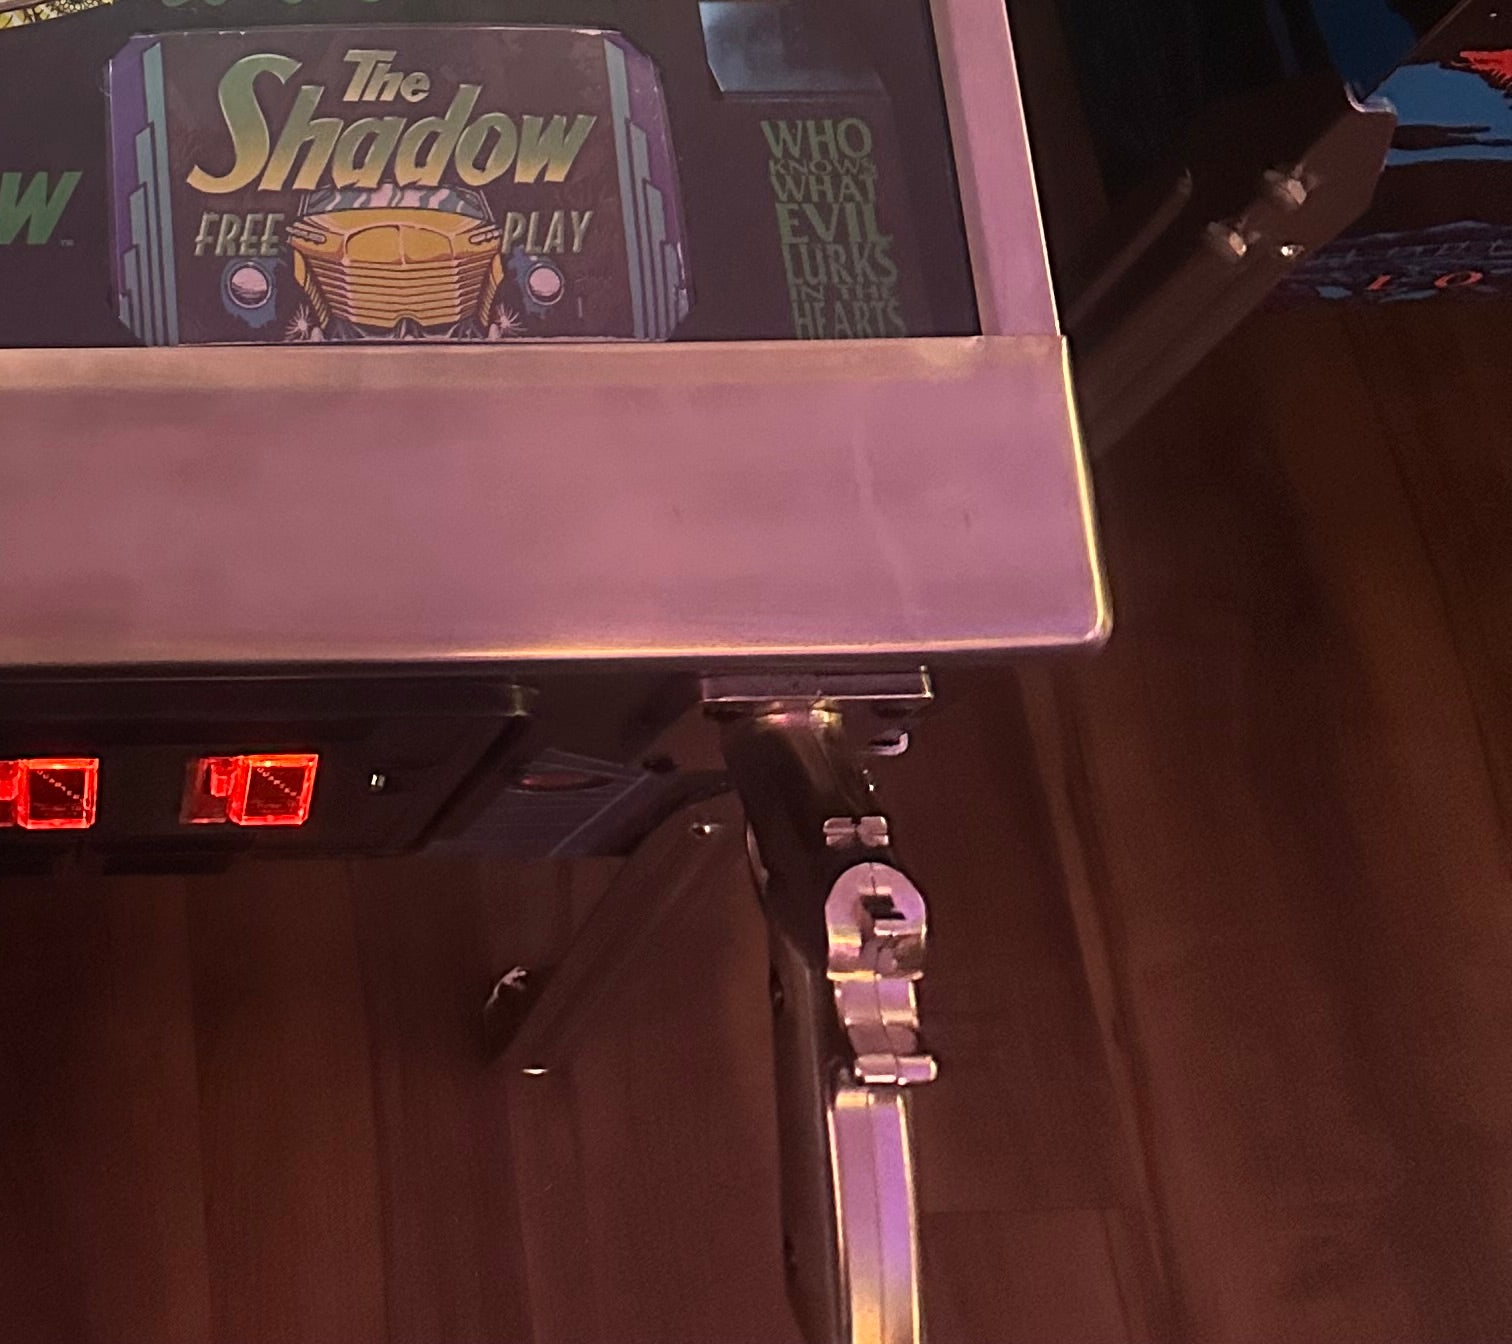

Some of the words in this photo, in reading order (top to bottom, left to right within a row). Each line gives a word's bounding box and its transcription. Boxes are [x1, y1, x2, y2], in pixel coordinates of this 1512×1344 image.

[341, 48, 431, 104] The
[186, 52, 598, 195] Shadow
[760, 117, 873, 160] WHO
[768, 159, 878, 181] KNOWS
[770, 175, 878, 204] WHAT
[193, 211, 285, 256] FREE
[502, 209, 593, 255] PLAY
[775, 201, 894, 247] EVIL
[781, 242, 899, 287] LURKS
[790, 283, 825, 304] IN
[791, 300, 908, 340] HEARTS
